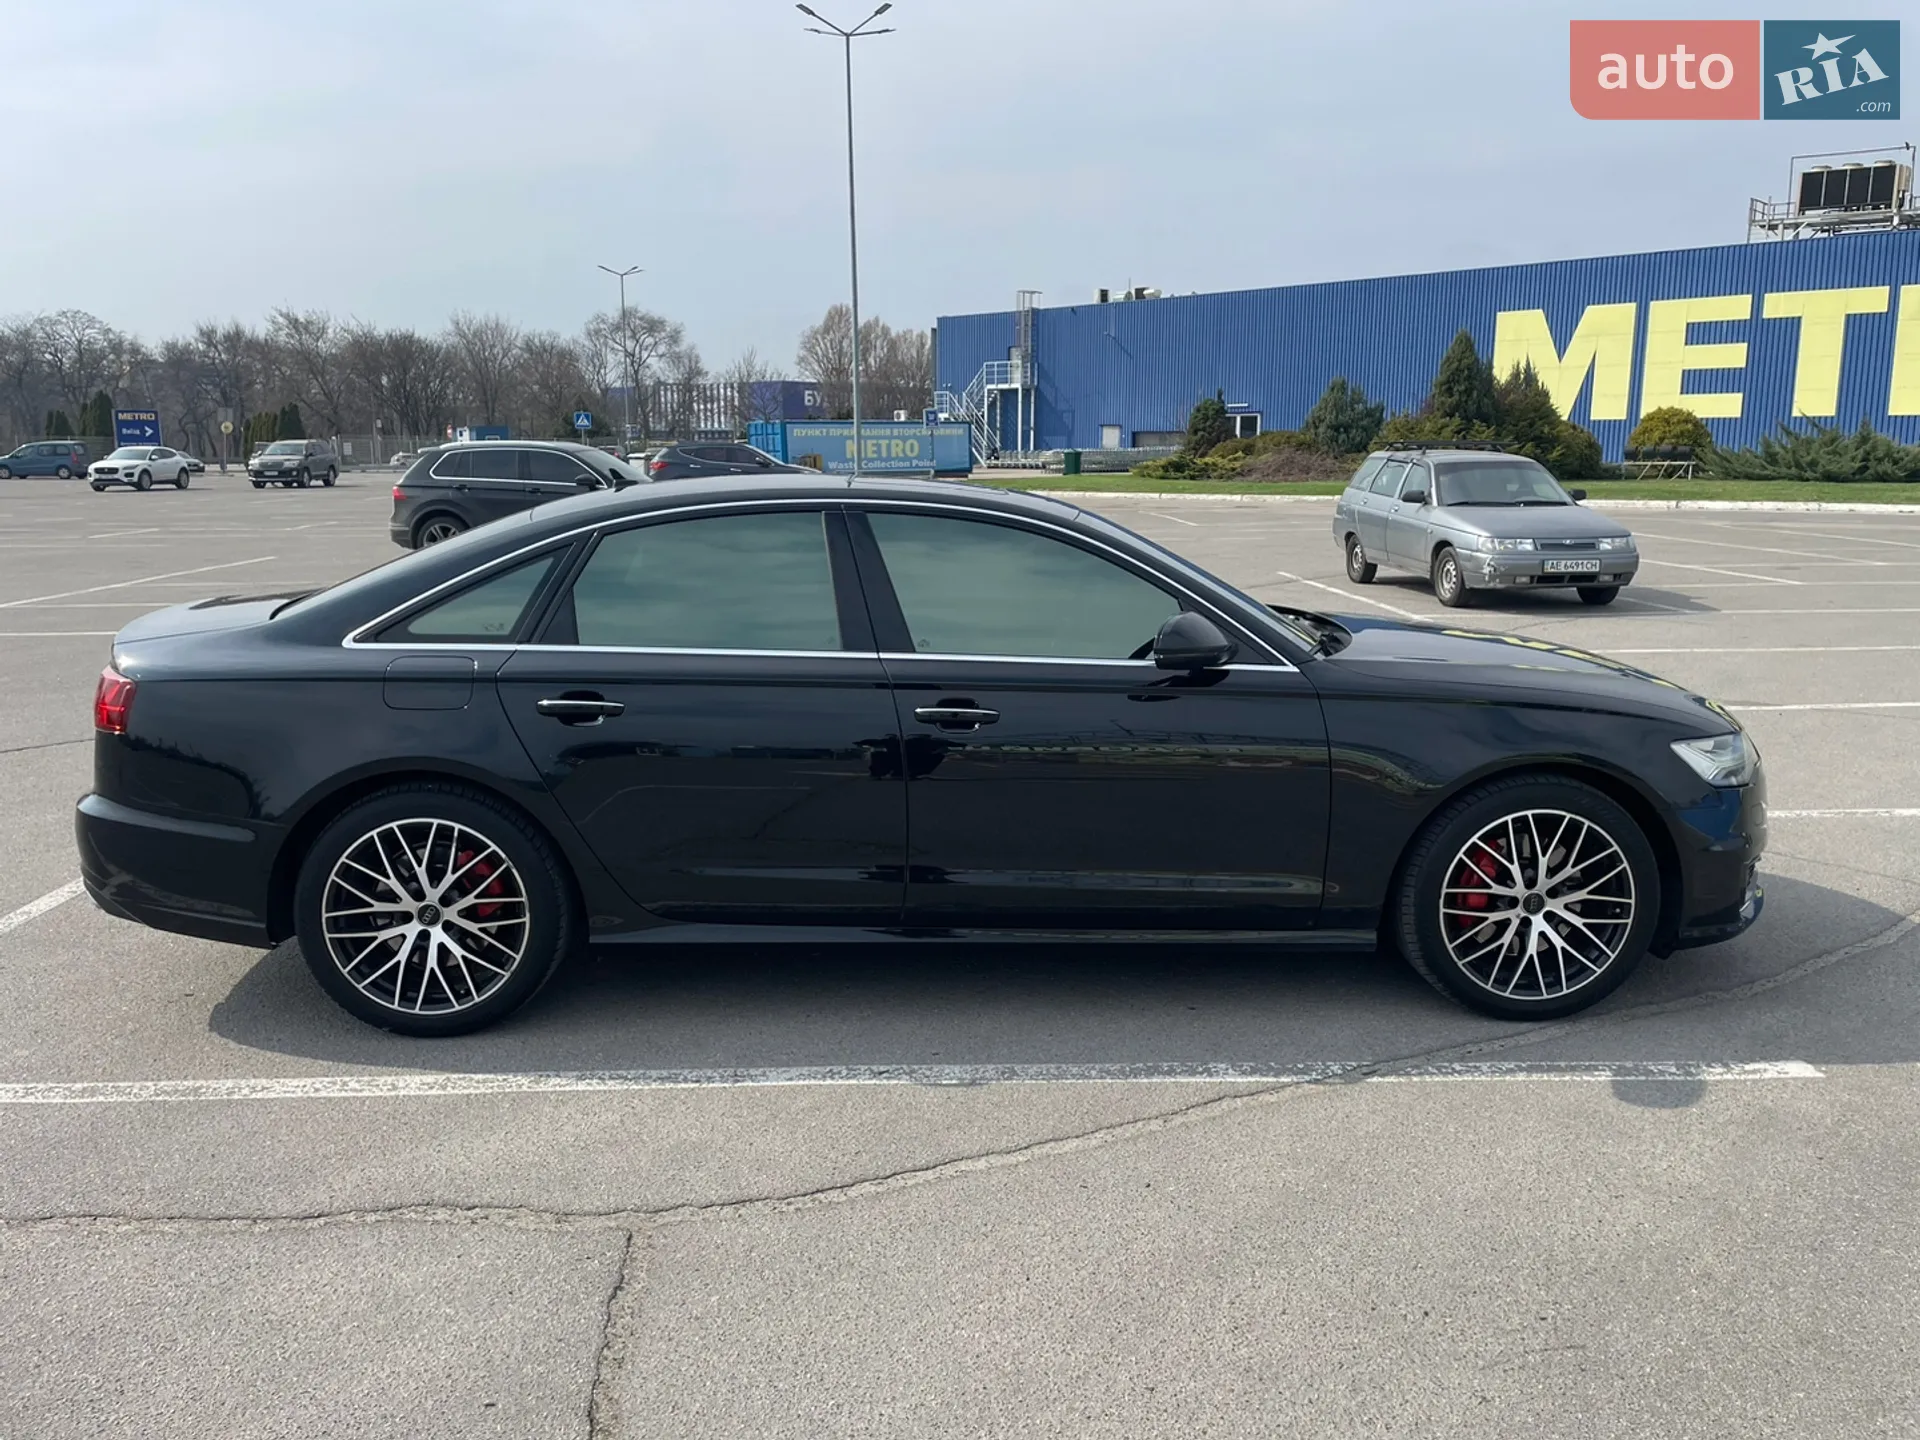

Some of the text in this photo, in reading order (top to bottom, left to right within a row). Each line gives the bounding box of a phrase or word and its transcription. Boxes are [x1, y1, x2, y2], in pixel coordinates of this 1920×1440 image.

[117, 412, 156, 421] METRO
[794, 427, 827, 436] ПУНКТ
[845, 438, 920, 459] METRO
[861, 459, 911, 468] Collection
[911, 459, 937, 467] Point
